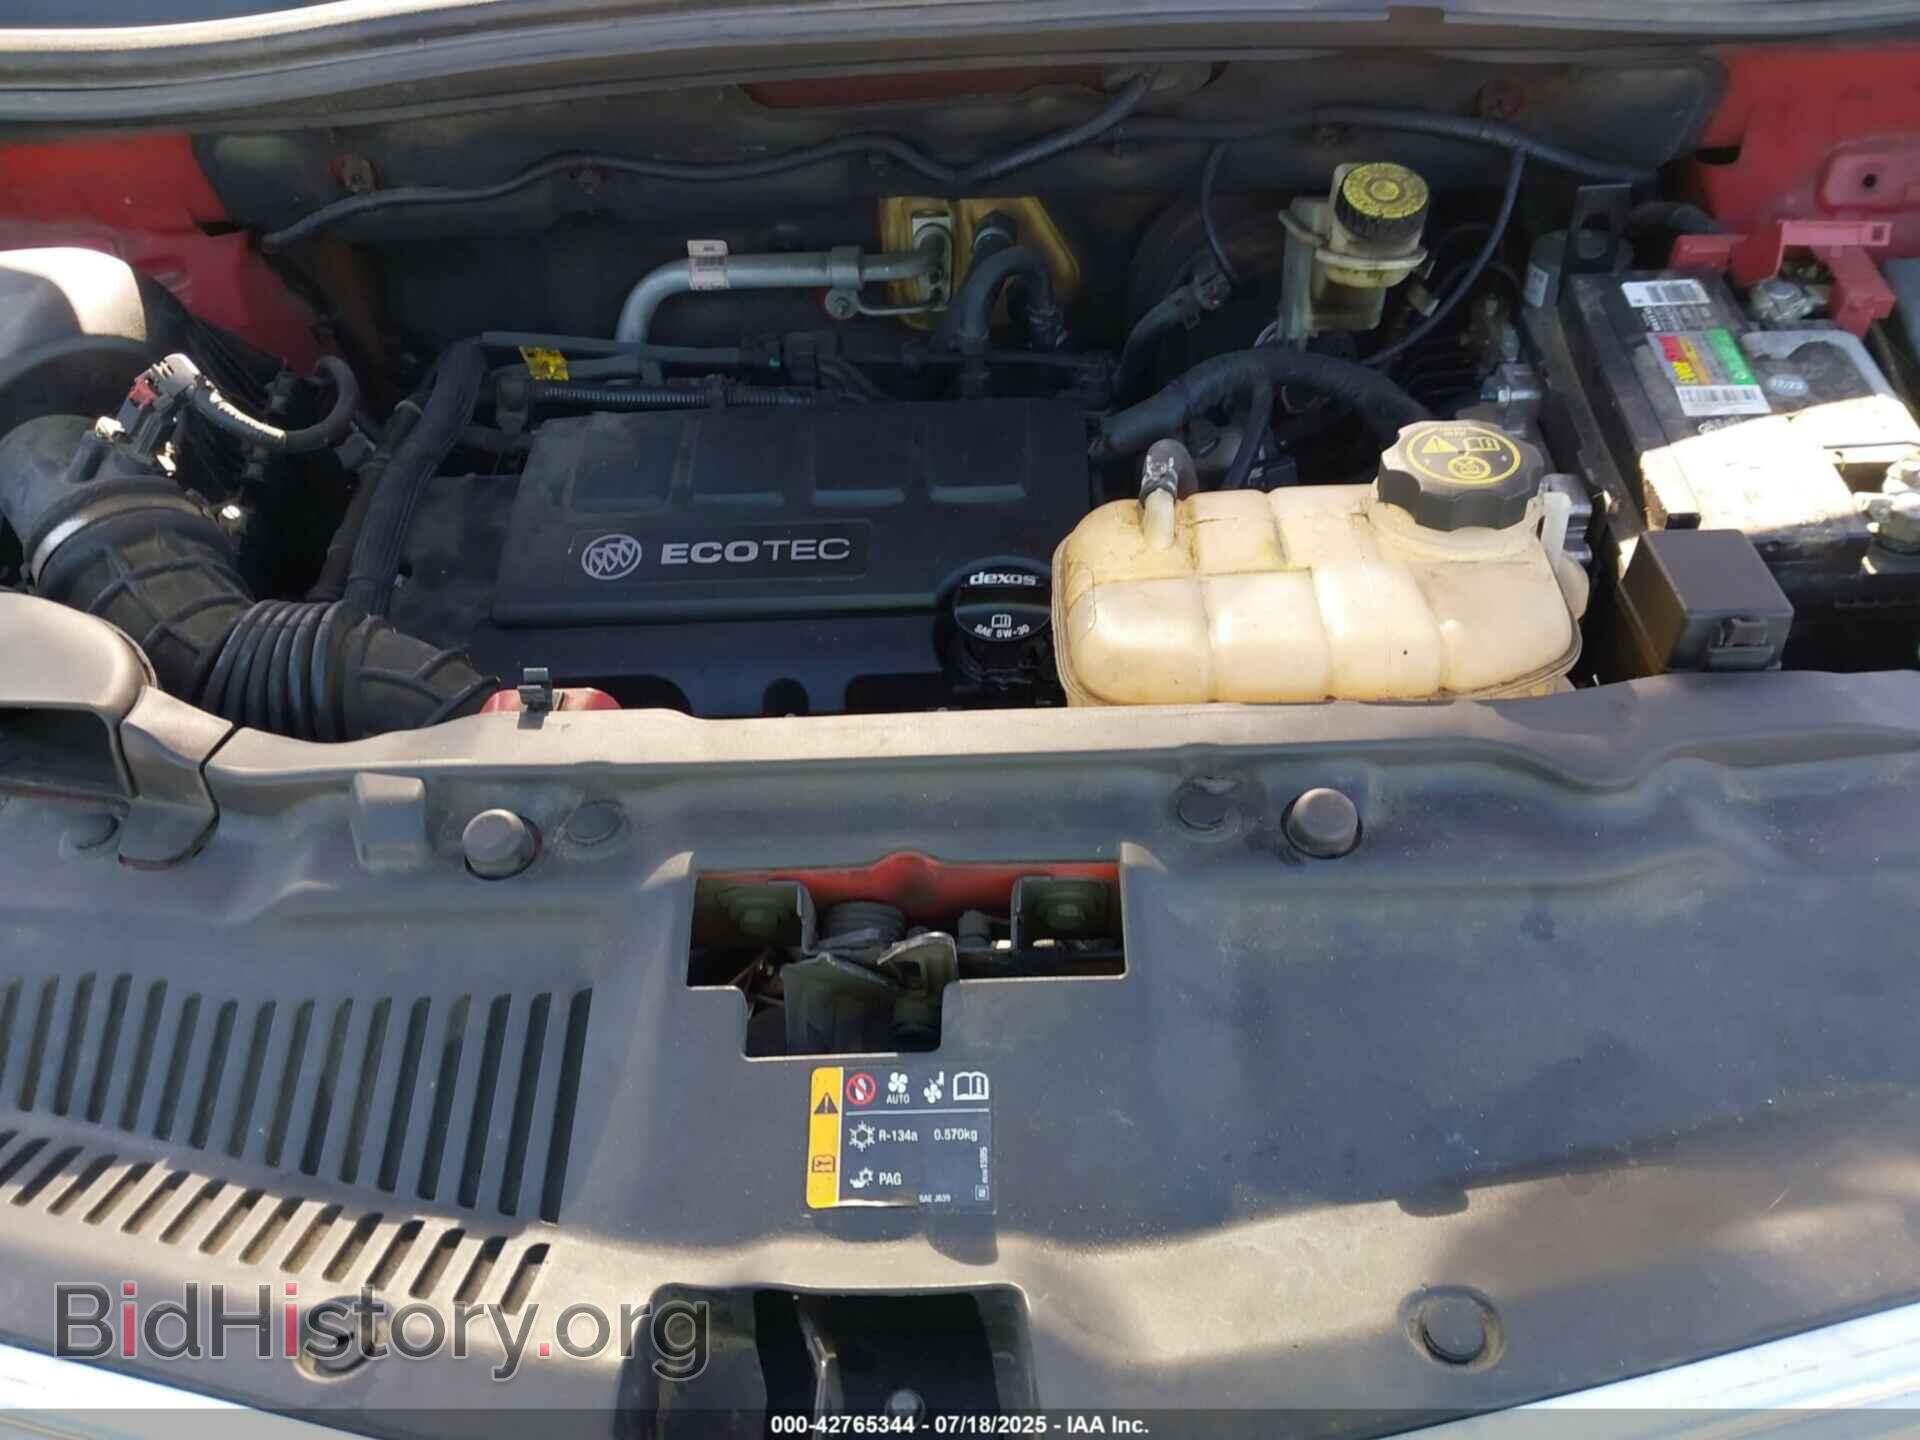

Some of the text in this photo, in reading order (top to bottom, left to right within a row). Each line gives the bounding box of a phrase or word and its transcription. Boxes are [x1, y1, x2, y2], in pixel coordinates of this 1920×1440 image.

[660, 537, 851, 565] ECOTEC
[969, 571, 1037, 586] dexos
[974, 623, 993, 637] SAE
[886, 1095, 910, 1104] AUTO
[878, 1128, 978, 1143] R-134a 0.570kg
[878, 1173, 902, 1186] PAG
